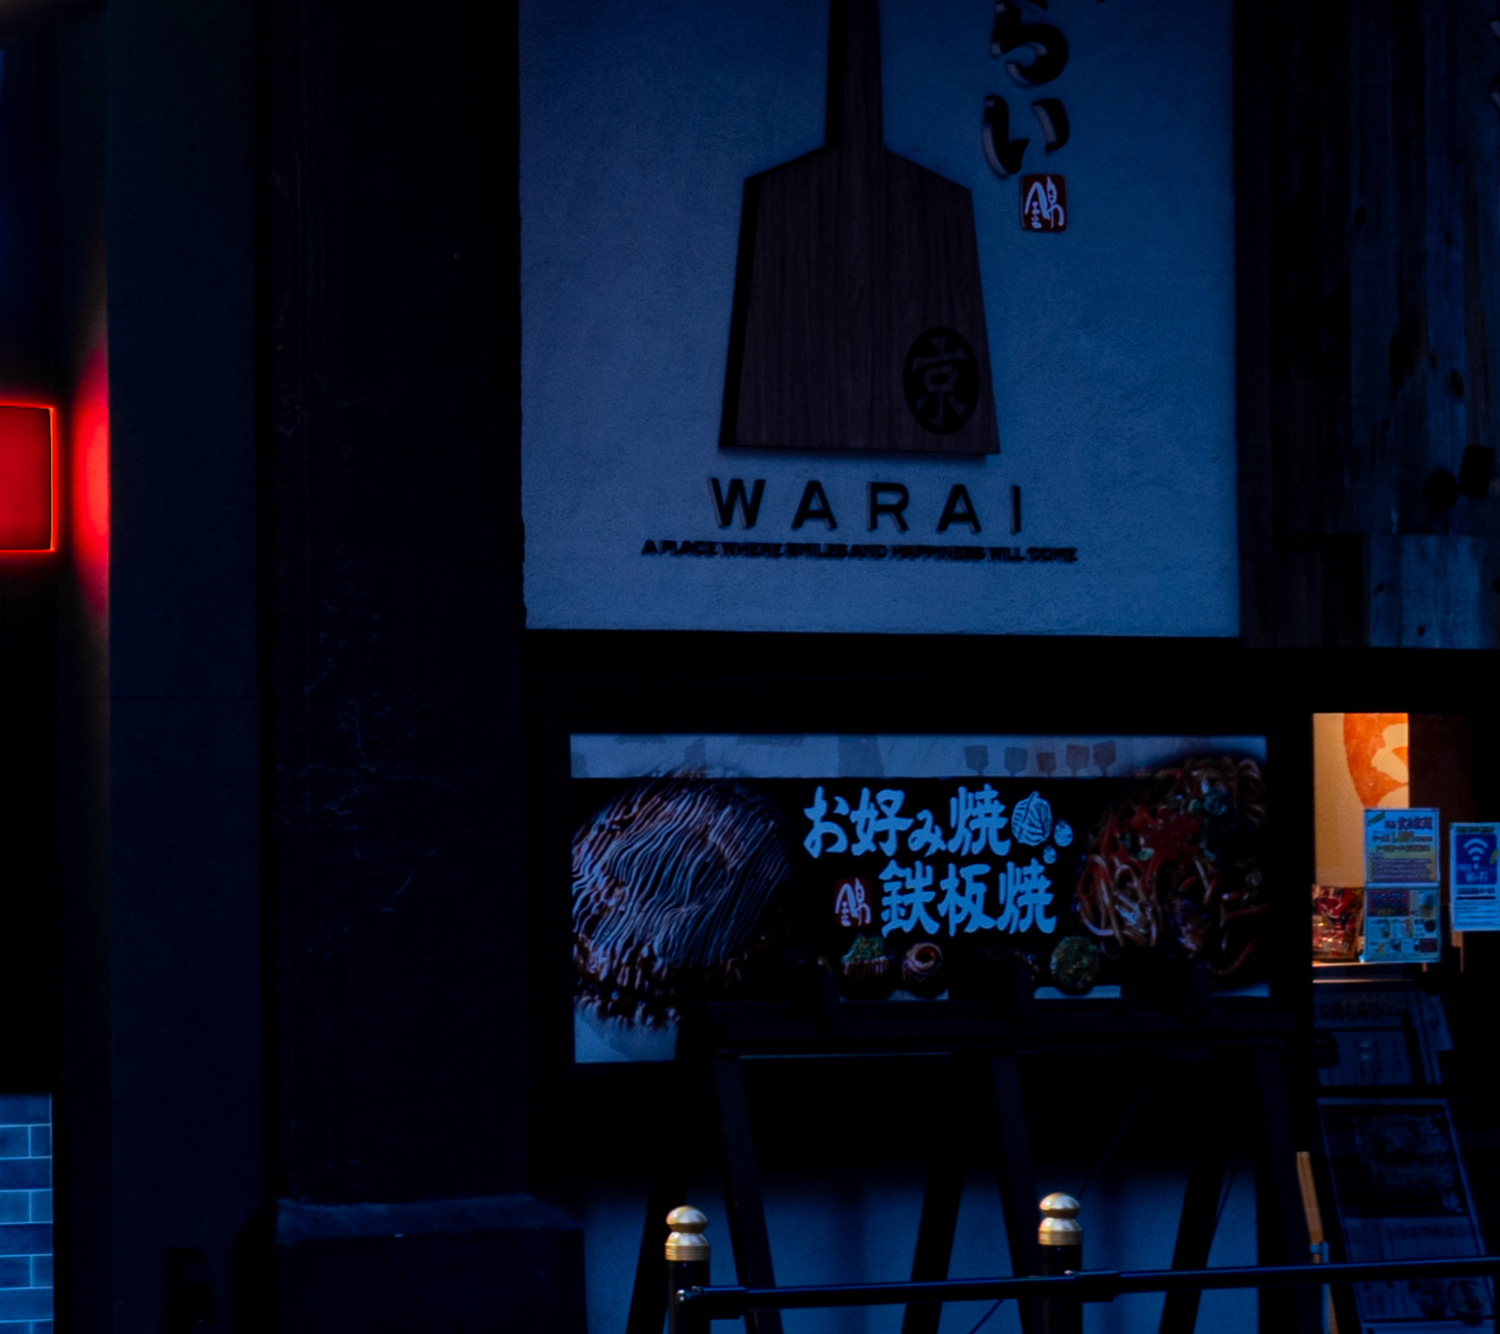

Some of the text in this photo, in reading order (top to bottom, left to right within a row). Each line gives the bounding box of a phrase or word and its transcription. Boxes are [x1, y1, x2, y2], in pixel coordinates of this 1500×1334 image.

[909, 335, 969, 427] 京
[707, 477, 1022, 535] WARAI
[641, 539, 1078, 564] A PLACE WHERE SMILES AND HAPPINESS WILL COME
